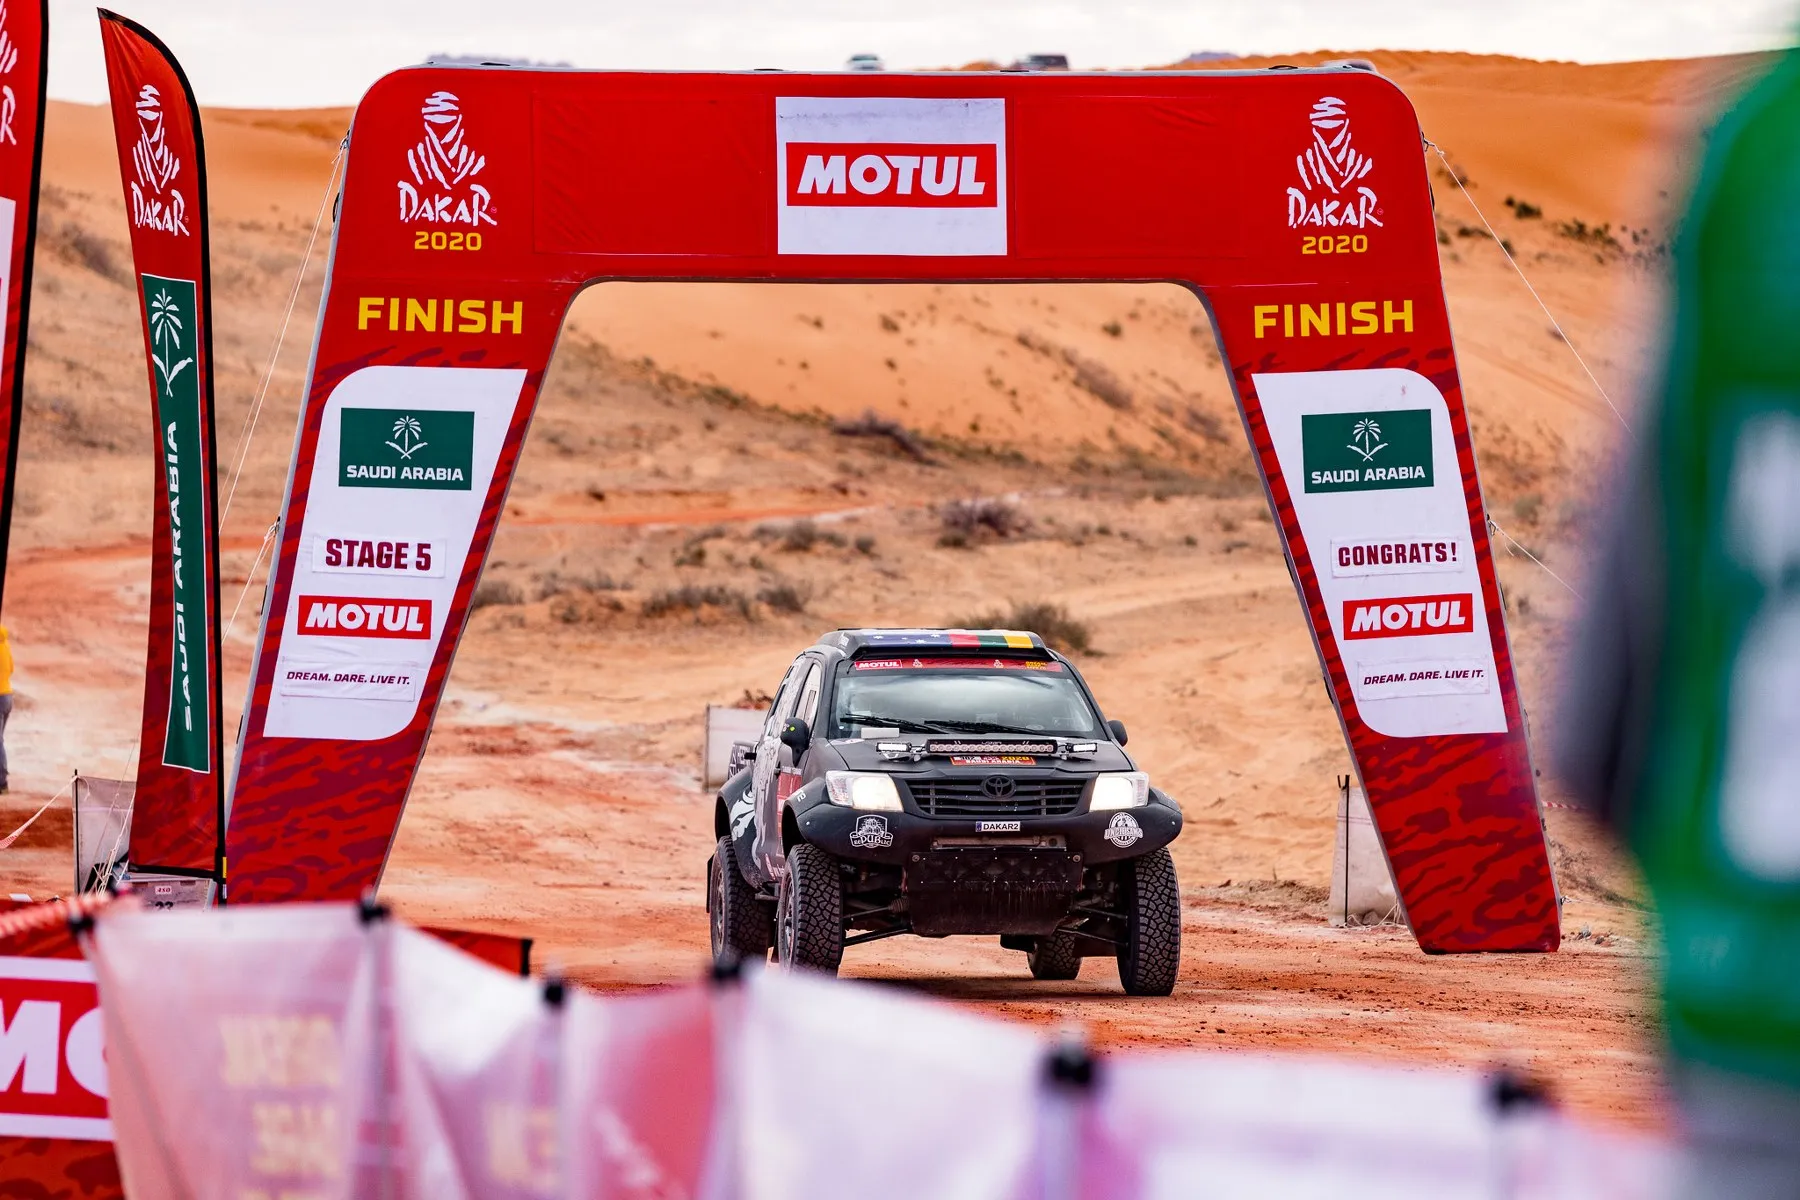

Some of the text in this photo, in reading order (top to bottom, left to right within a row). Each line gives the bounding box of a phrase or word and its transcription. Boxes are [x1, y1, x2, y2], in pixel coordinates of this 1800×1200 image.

[797, 154, 986, 196] MOTUL
[130, 181, 190, 237] DAKAR
[397, 181, 498, 227] DAKAR
[1286, 186, 1384, 229] DAKAR
[414, 231, 482, 251] 2020
[1302, 234, 1368, 255] 2020
[358, 297, 523, 334] FINISH
[1254, 299, 1414, 339] FINISH
[346, 465, 464, 481] SAUDI ARABIA
[1311, 465, 1426, 484] SAUDI ARABIA
[325, 539, 432, 572] STAGE 5
[1338, 542, 1457, 567] CONGRATS!
[167, 421, 192, 732] SAUDI ARABIA
[305, 602, 424, 632] MOTUL
[1350, 600, 1466, 632] MOTUL
[286, 671, 410, 685] DREAM. DARE. LIVE IT.
[858, 661, 900, 669] MOTUL
[1363, 669, 1484, 686] DREAM. DARE. LIVE IT.
